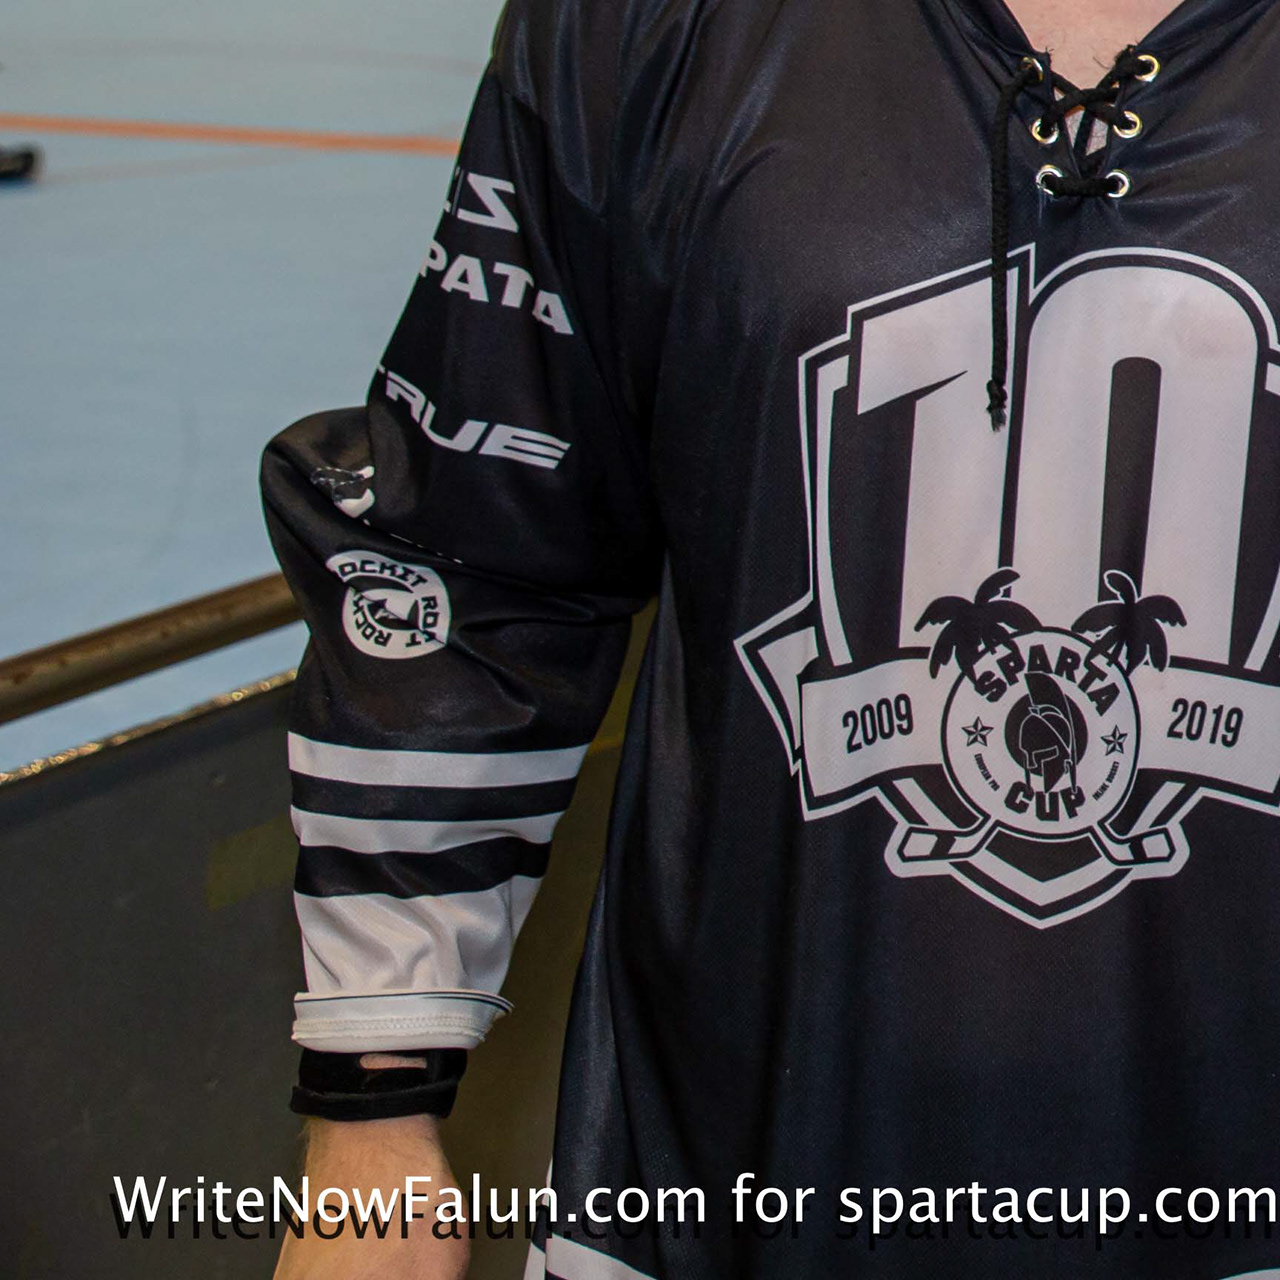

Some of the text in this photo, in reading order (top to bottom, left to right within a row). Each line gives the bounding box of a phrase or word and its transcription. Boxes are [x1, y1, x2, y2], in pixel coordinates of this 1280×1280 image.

[379, 365, 572, 470] RUE
[857, 266, 1260, 668] 10
[974, 644, 1121, 718] SPARTA
[841, 692, 915, 755] 2009
[1166, 697, 1246, 749] 2019
[1003, 780, 1087, 822] CUP
